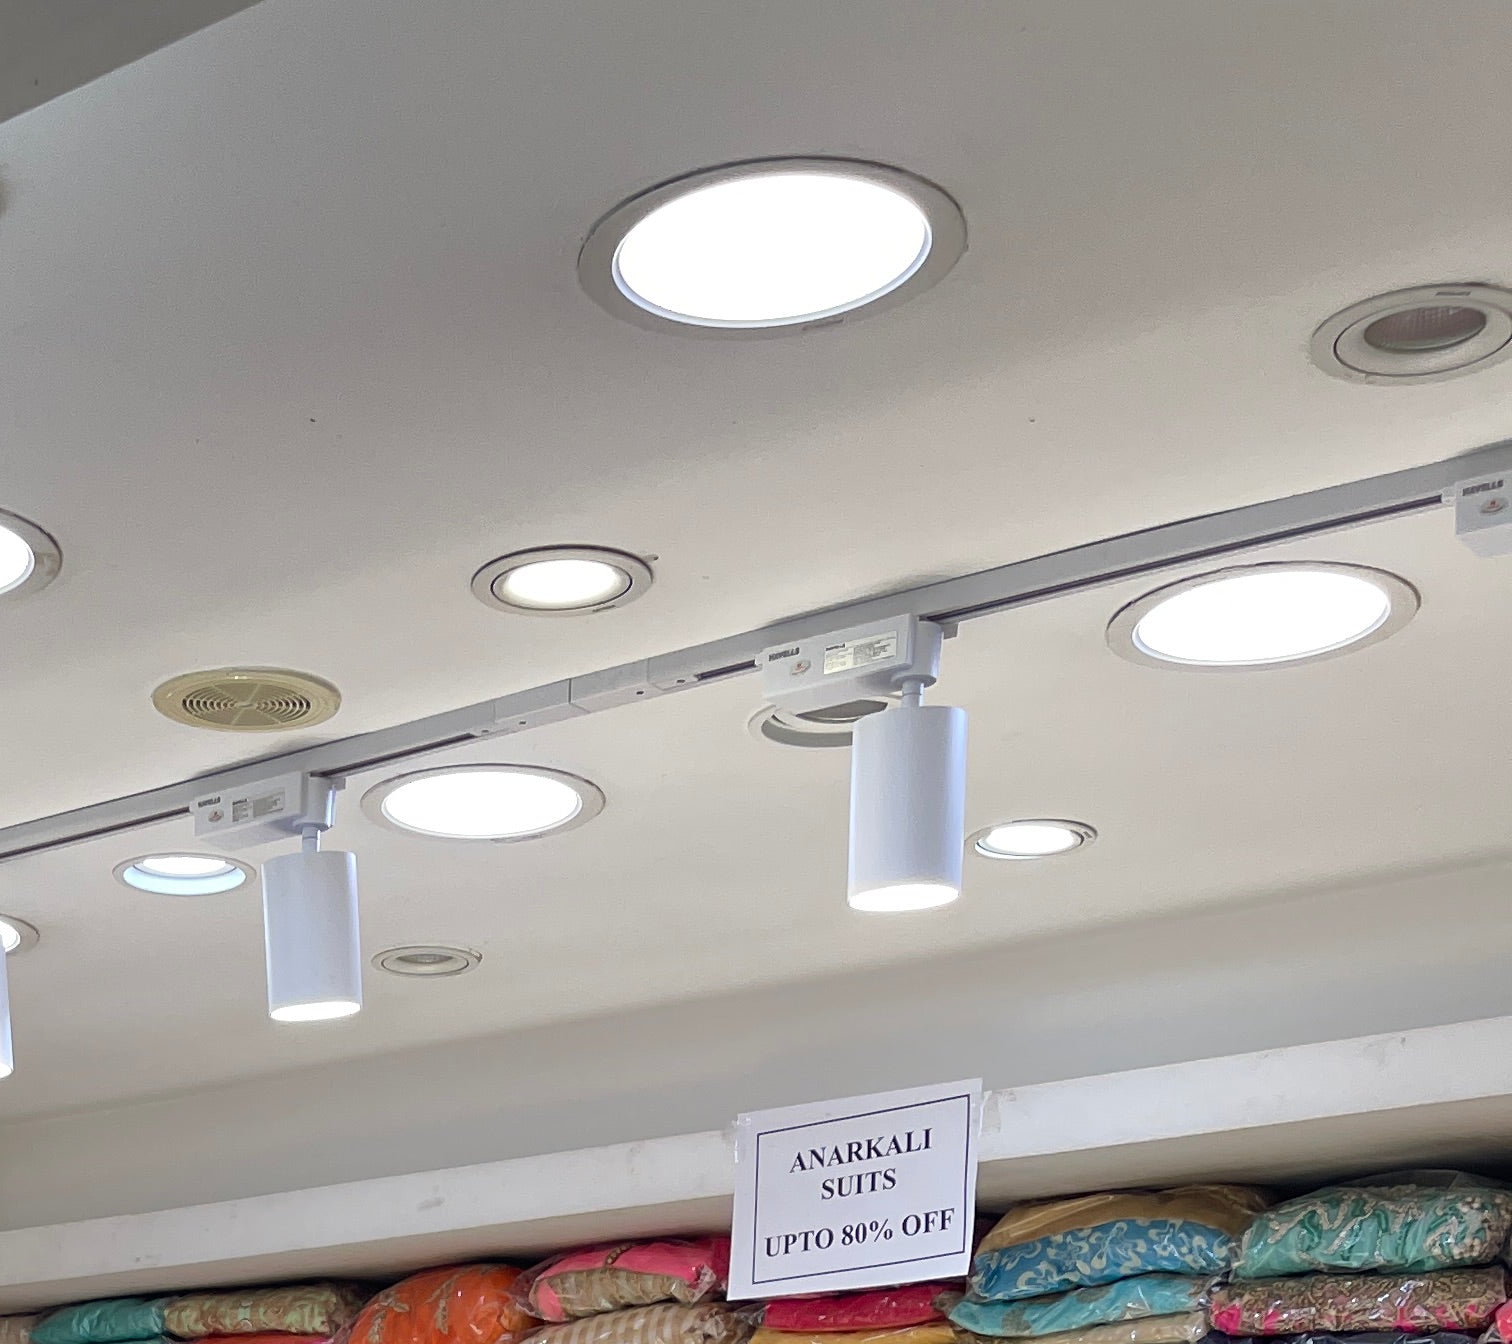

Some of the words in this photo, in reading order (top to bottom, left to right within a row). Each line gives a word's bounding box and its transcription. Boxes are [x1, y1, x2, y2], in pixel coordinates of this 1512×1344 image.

[789, 1127, 933, 1174] ANARKALI
[821, 1167, 897, 1201] SUITS
[764, 1227, 835, 1257] UPTO
[841, 1218, 893, 1246] 80%
[902, 1207, 956, 1237] OFF
